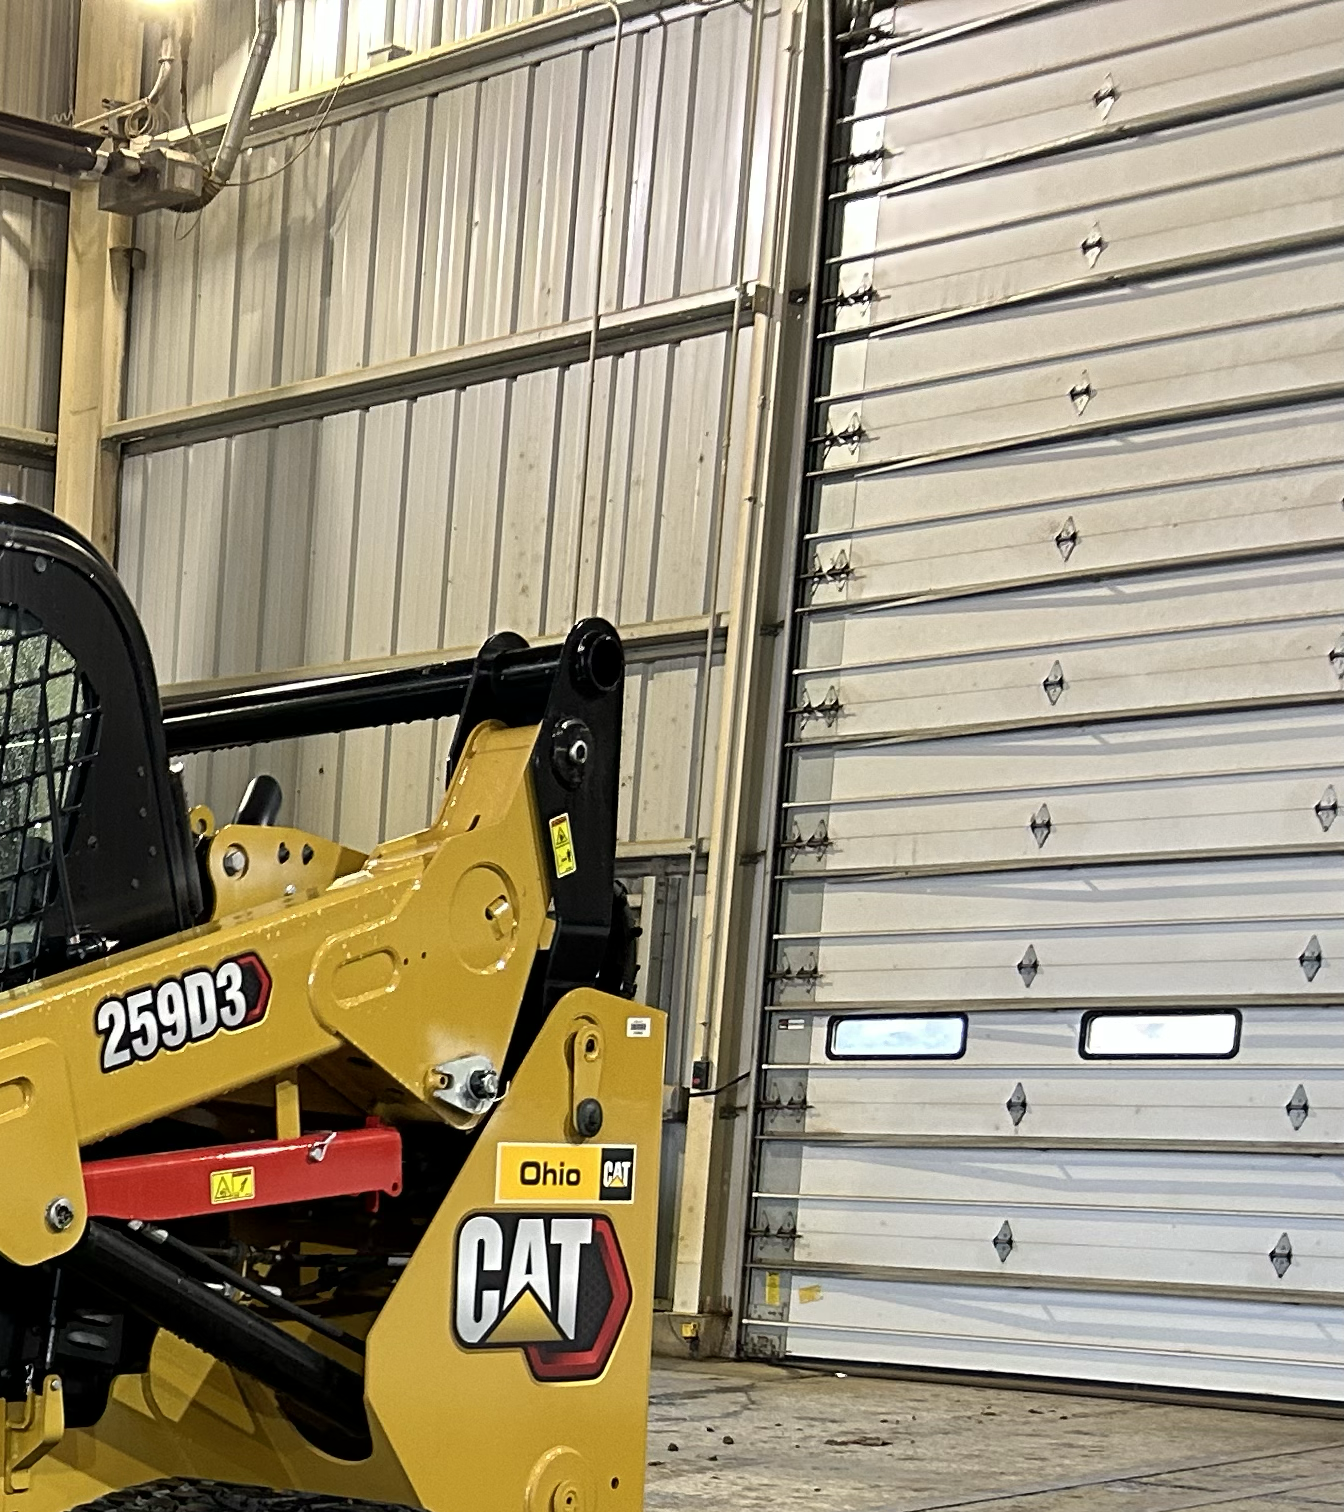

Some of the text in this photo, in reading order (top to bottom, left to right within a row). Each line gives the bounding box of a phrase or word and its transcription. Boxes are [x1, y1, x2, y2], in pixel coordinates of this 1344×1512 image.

[98, 961, 247, 1069] 259D3
[519, 1160, 632, 1188] Ohio CAT
[457, 1216, 593, 1344] CAT
